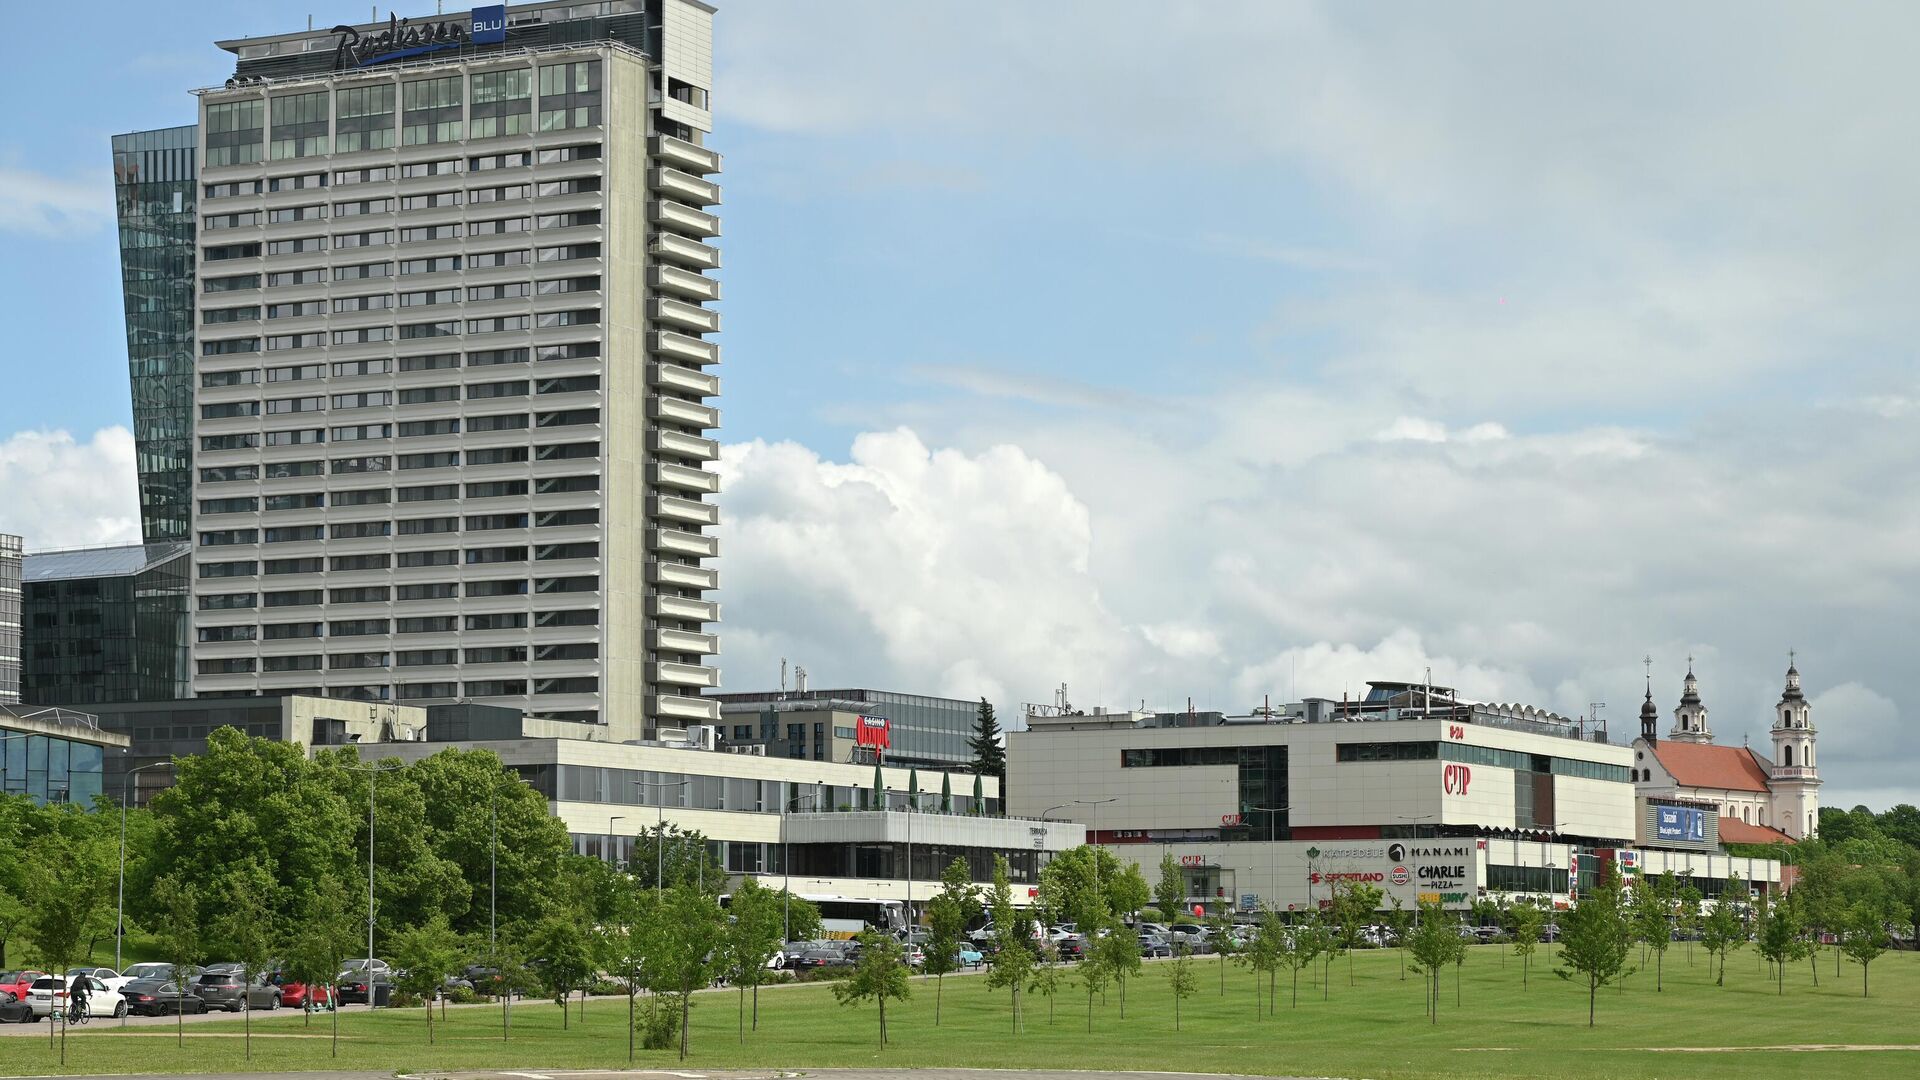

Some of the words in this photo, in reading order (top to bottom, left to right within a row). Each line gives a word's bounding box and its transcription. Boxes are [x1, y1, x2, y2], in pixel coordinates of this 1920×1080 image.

[330, 11, 469, 70] Radisson
[473, 20, 502, 32] BLU
[864, 716, 885, 727] CASINO
[1444, 764, 1471, 796] CUP
[1222, 814, 1242, 824] CUP
[1181, 855, 1202, 865] CUP
[1325, 872, 1384, 882] SPORTLAND
[1418, 865, 1466, 879] CHARLIE
[1431, 881, 1454, 889] PIZZA
[1418, 891, 1469, 903] SUBWAY
